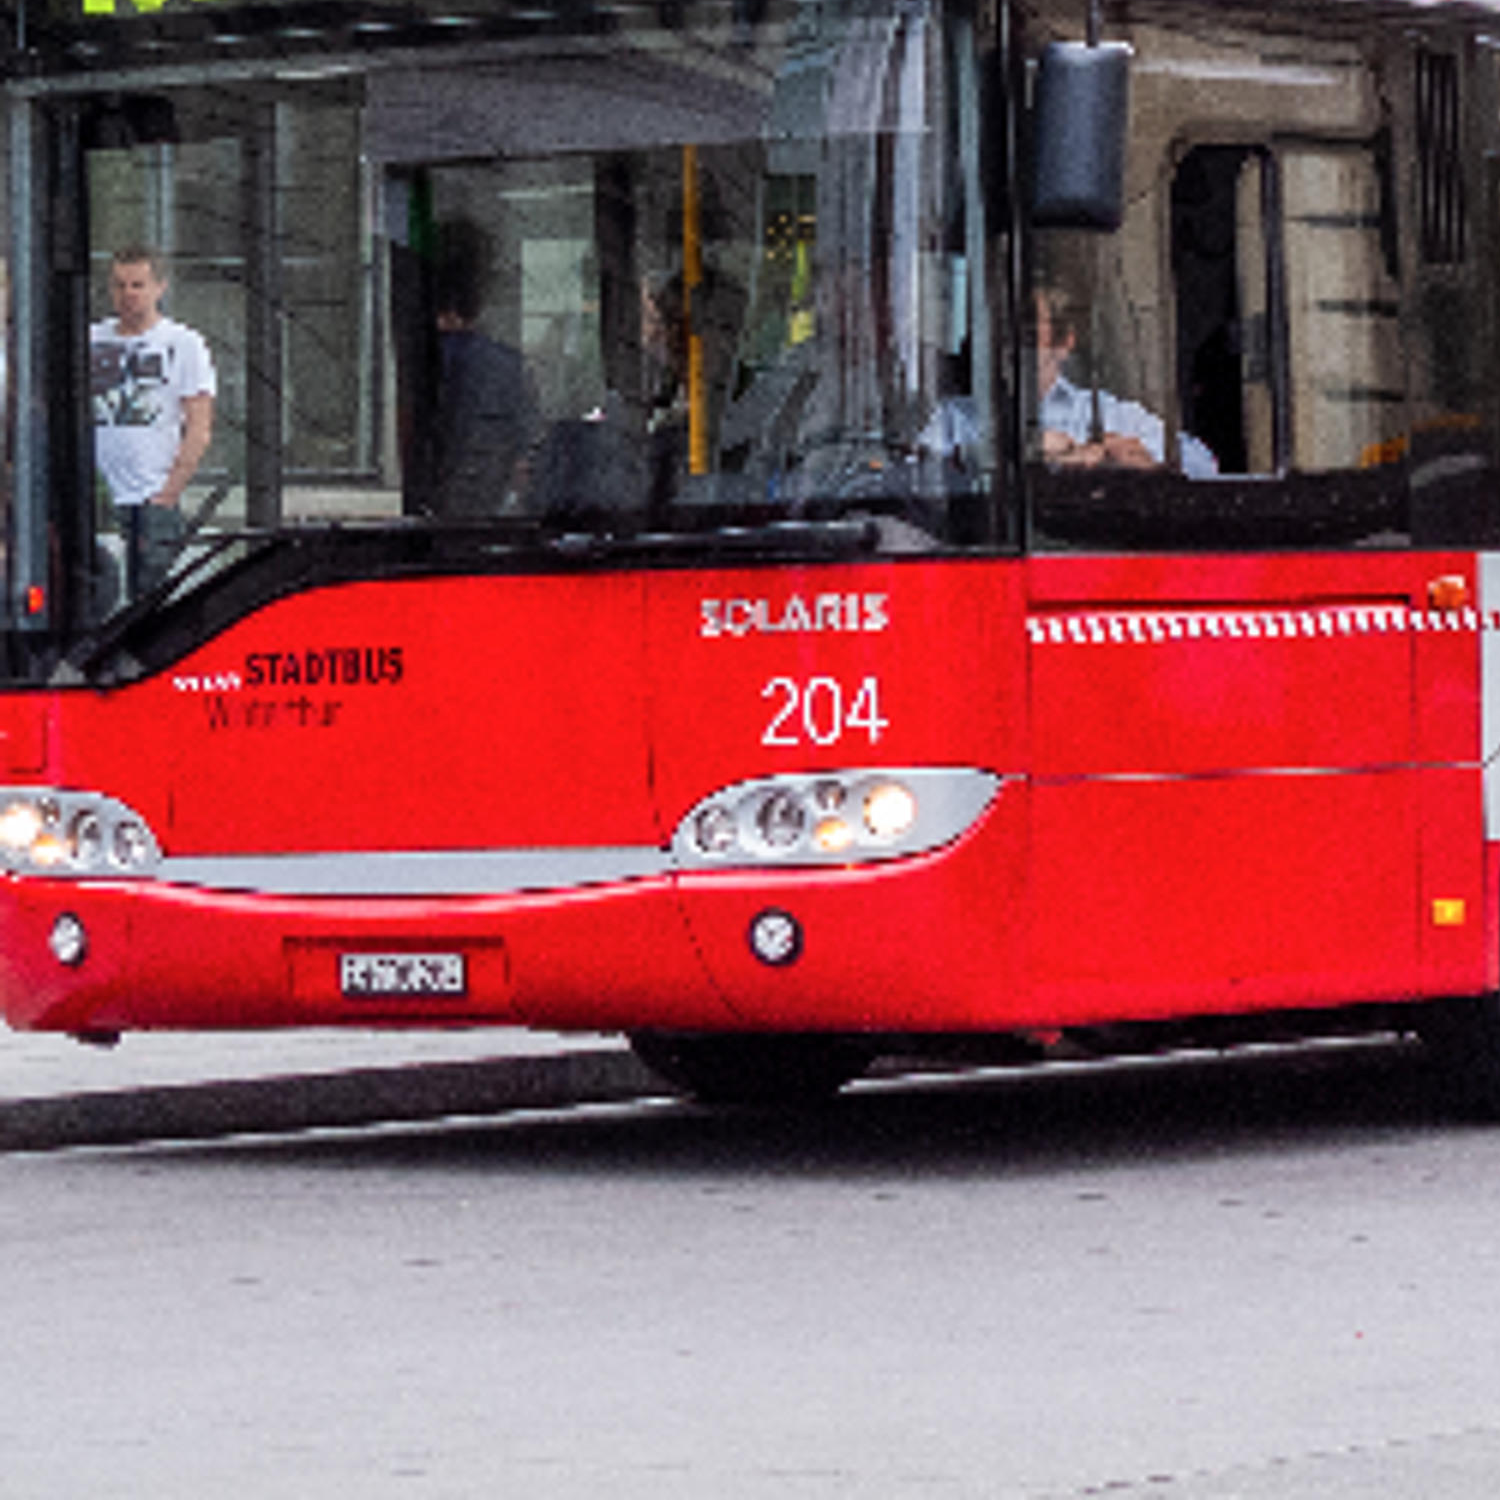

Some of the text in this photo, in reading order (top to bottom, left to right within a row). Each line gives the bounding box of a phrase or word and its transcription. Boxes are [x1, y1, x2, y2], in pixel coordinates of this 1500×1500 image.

[700, 593, 889, 637] SOLARIS
[245, 647, 404, 686] STADTBUS
[760, 676, 890, 745] 204
